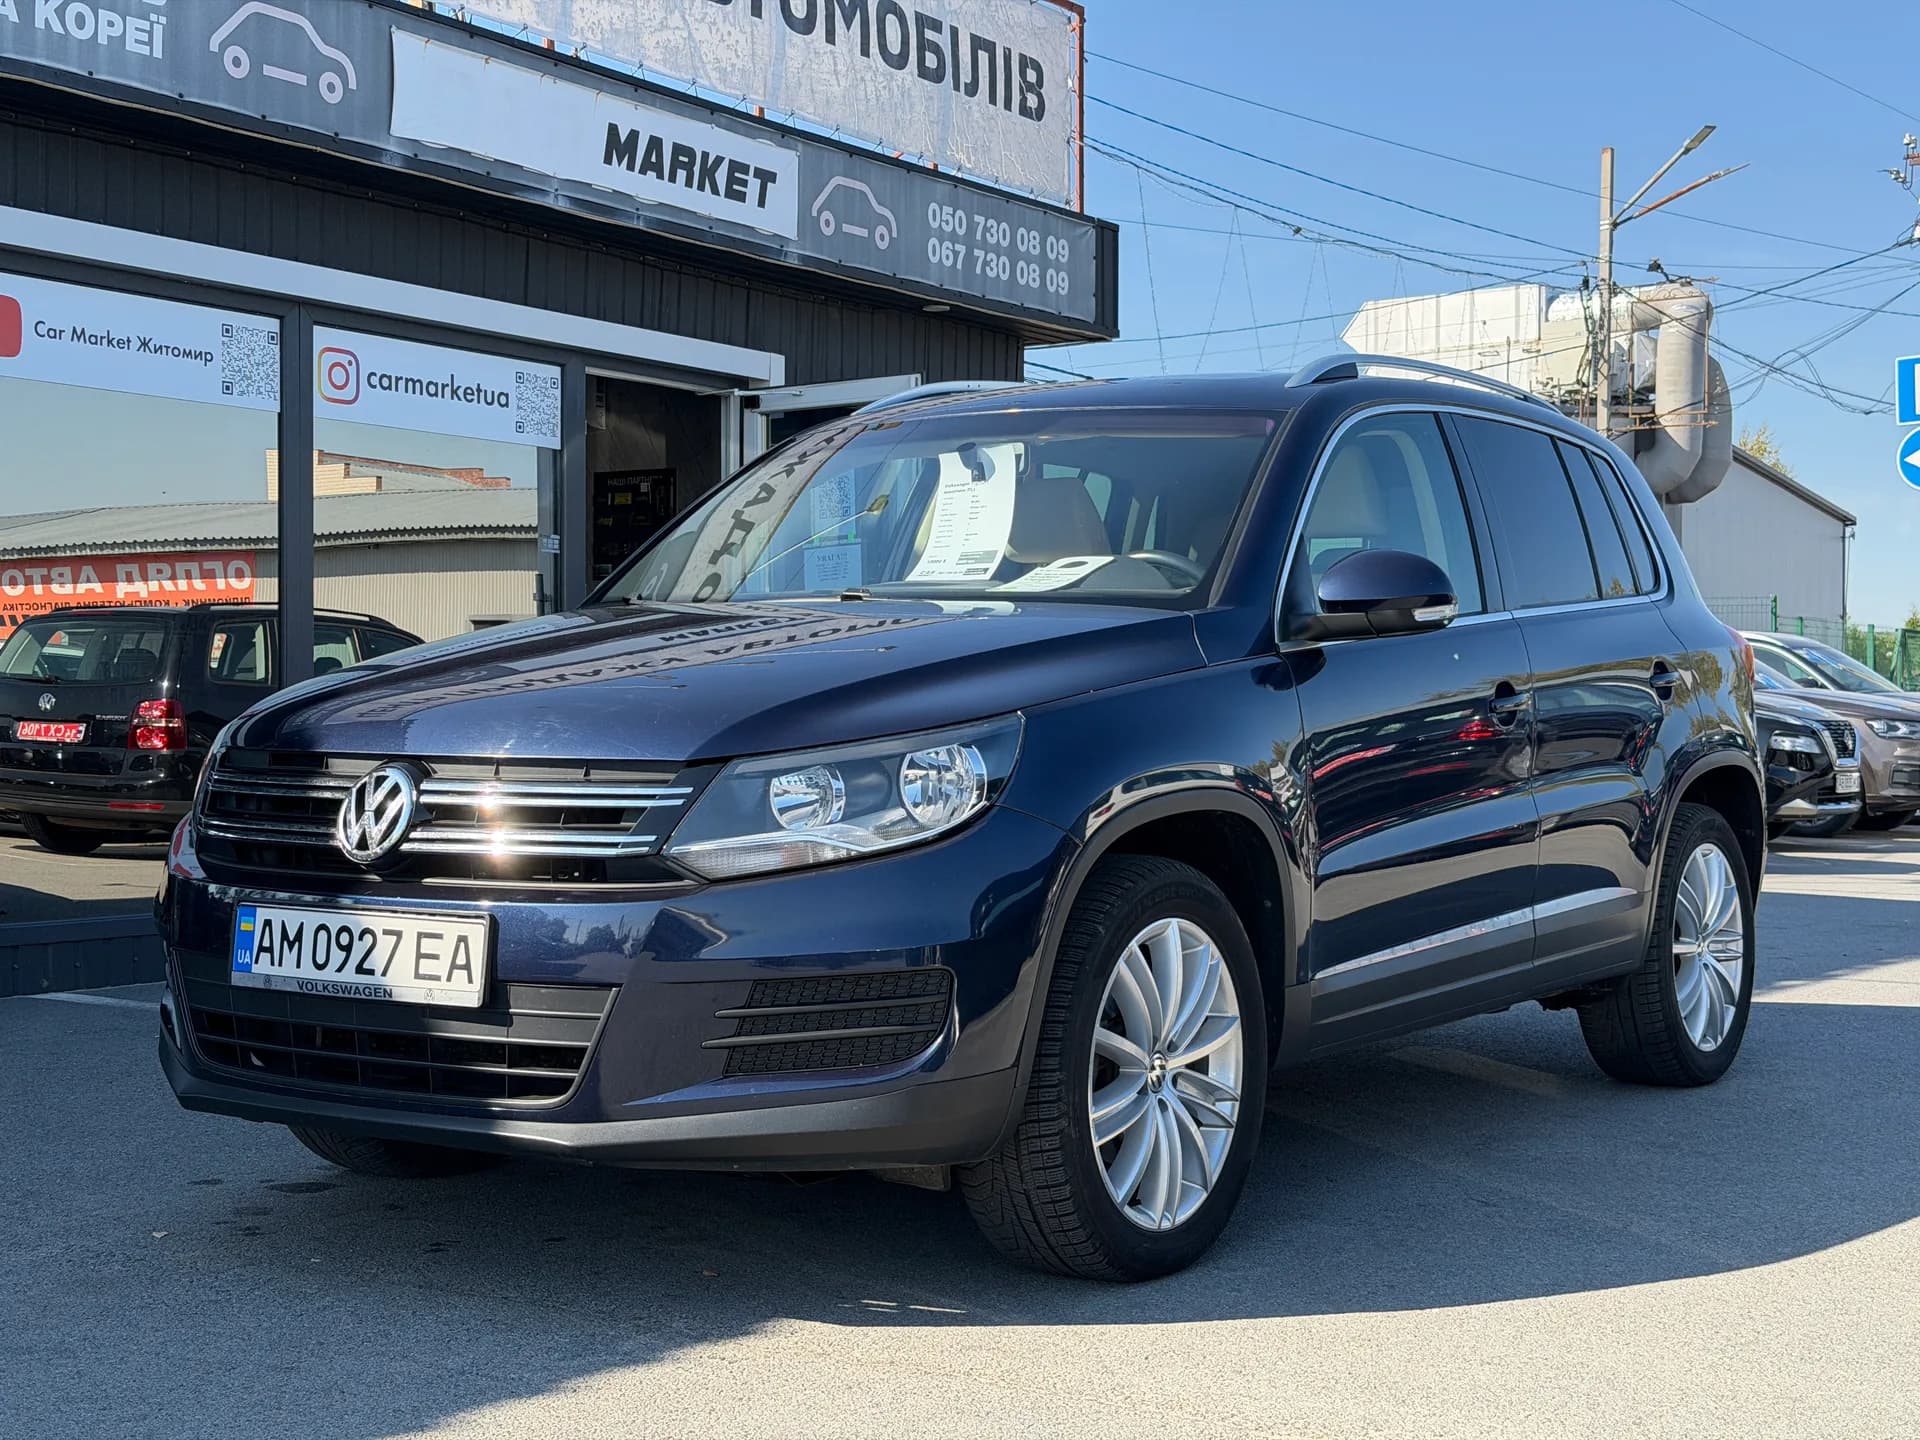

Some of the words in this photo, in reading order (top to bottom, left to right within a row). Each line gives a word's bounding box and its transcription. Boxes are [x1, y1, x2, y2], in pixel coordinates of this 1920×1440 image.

[34, 0, 167, 59] КОРЕЇ
[603, 122, 777, 209] MARKET
[928, 202, 967, 236] 050
[974, 214, 1011, 247] 730
[1016, 227, 1041, 255] 08
[1046, 235, 1070, 263] 09
[927, 237, 966, 270] 067
[973, 248, 1010, 281] 730
[1016, 260, 1040, 288] 08
[1046, 268, 1069, 295] 09
[34, 320, 66, 341] Car
[70, 326, 132, 350] Market
[136, 335, 214, 366] Житомир
[366, 371, 510, 408] carmarketua
[237, 949, 251, 965] UA
[254, 918, 305, 969] AM
[311, 922, 404, 977] 0927
[413, 930, 474, 985] EA
[297, 981, 393, 999] VOLKSWAGEN
